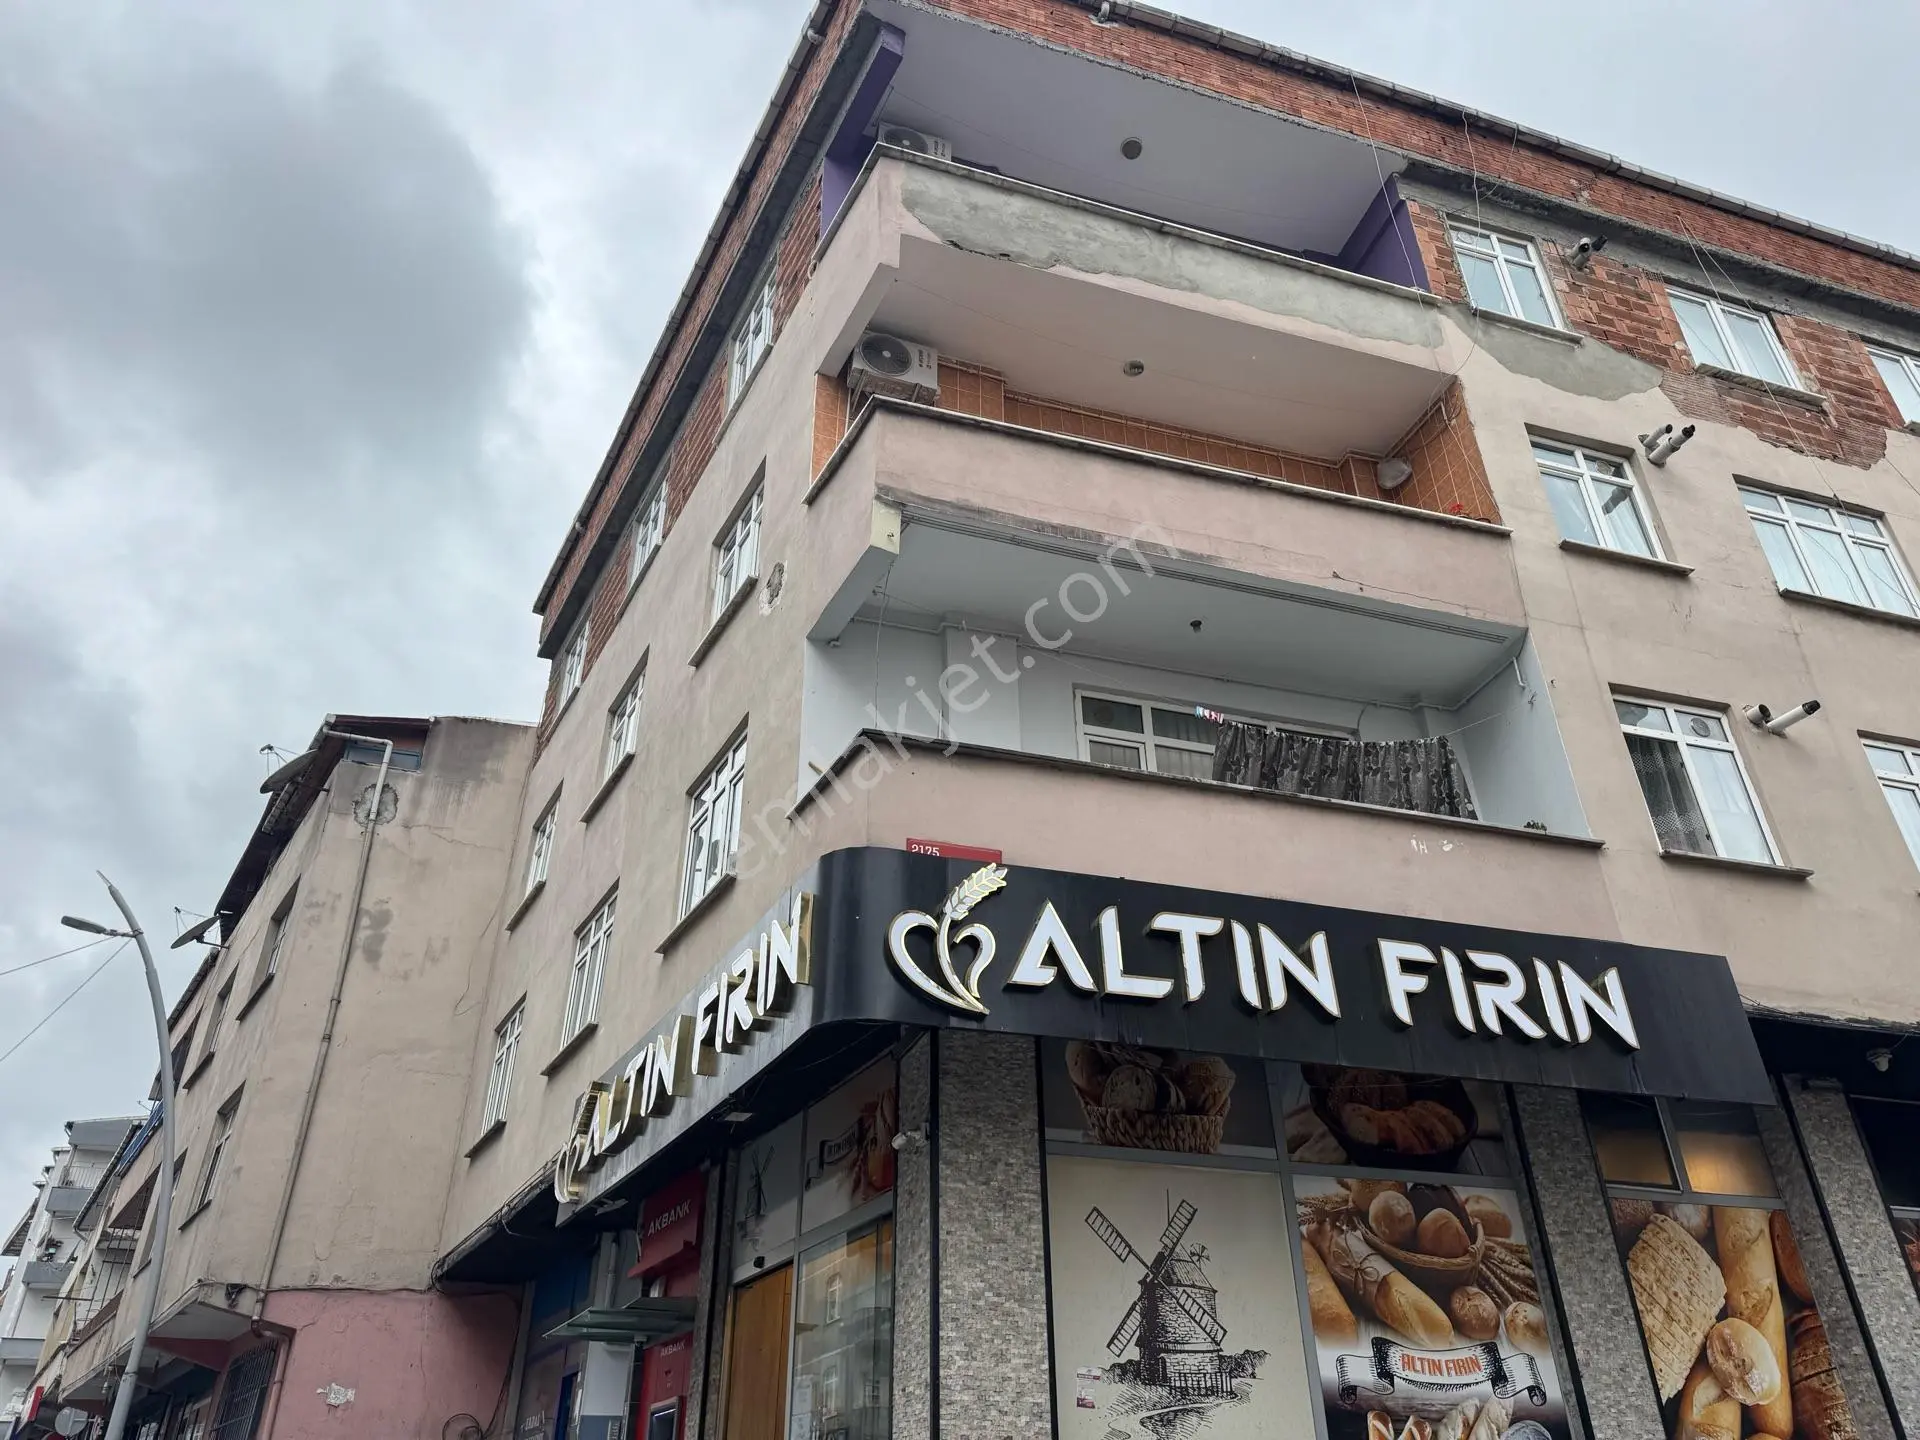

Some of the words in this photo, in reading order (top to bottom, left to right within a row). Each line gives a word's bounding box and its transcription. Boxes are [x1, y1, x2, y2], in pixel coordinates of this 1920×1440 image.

[911, 844, 940, 857] 2175
[1007, 900, 1341, 1019] ALTIN
[1377, 938, 1641, 1050] FIRIN
[578, 1014, 688, 1172] ALTIN
[692, 891, 808, 1075] FIRIN
[648, 1200, 691, 1237] AKBANK
[660, 1339, 685, 1359] AKBANK
[1400, 1353, 1443, 1377] ALTIN
